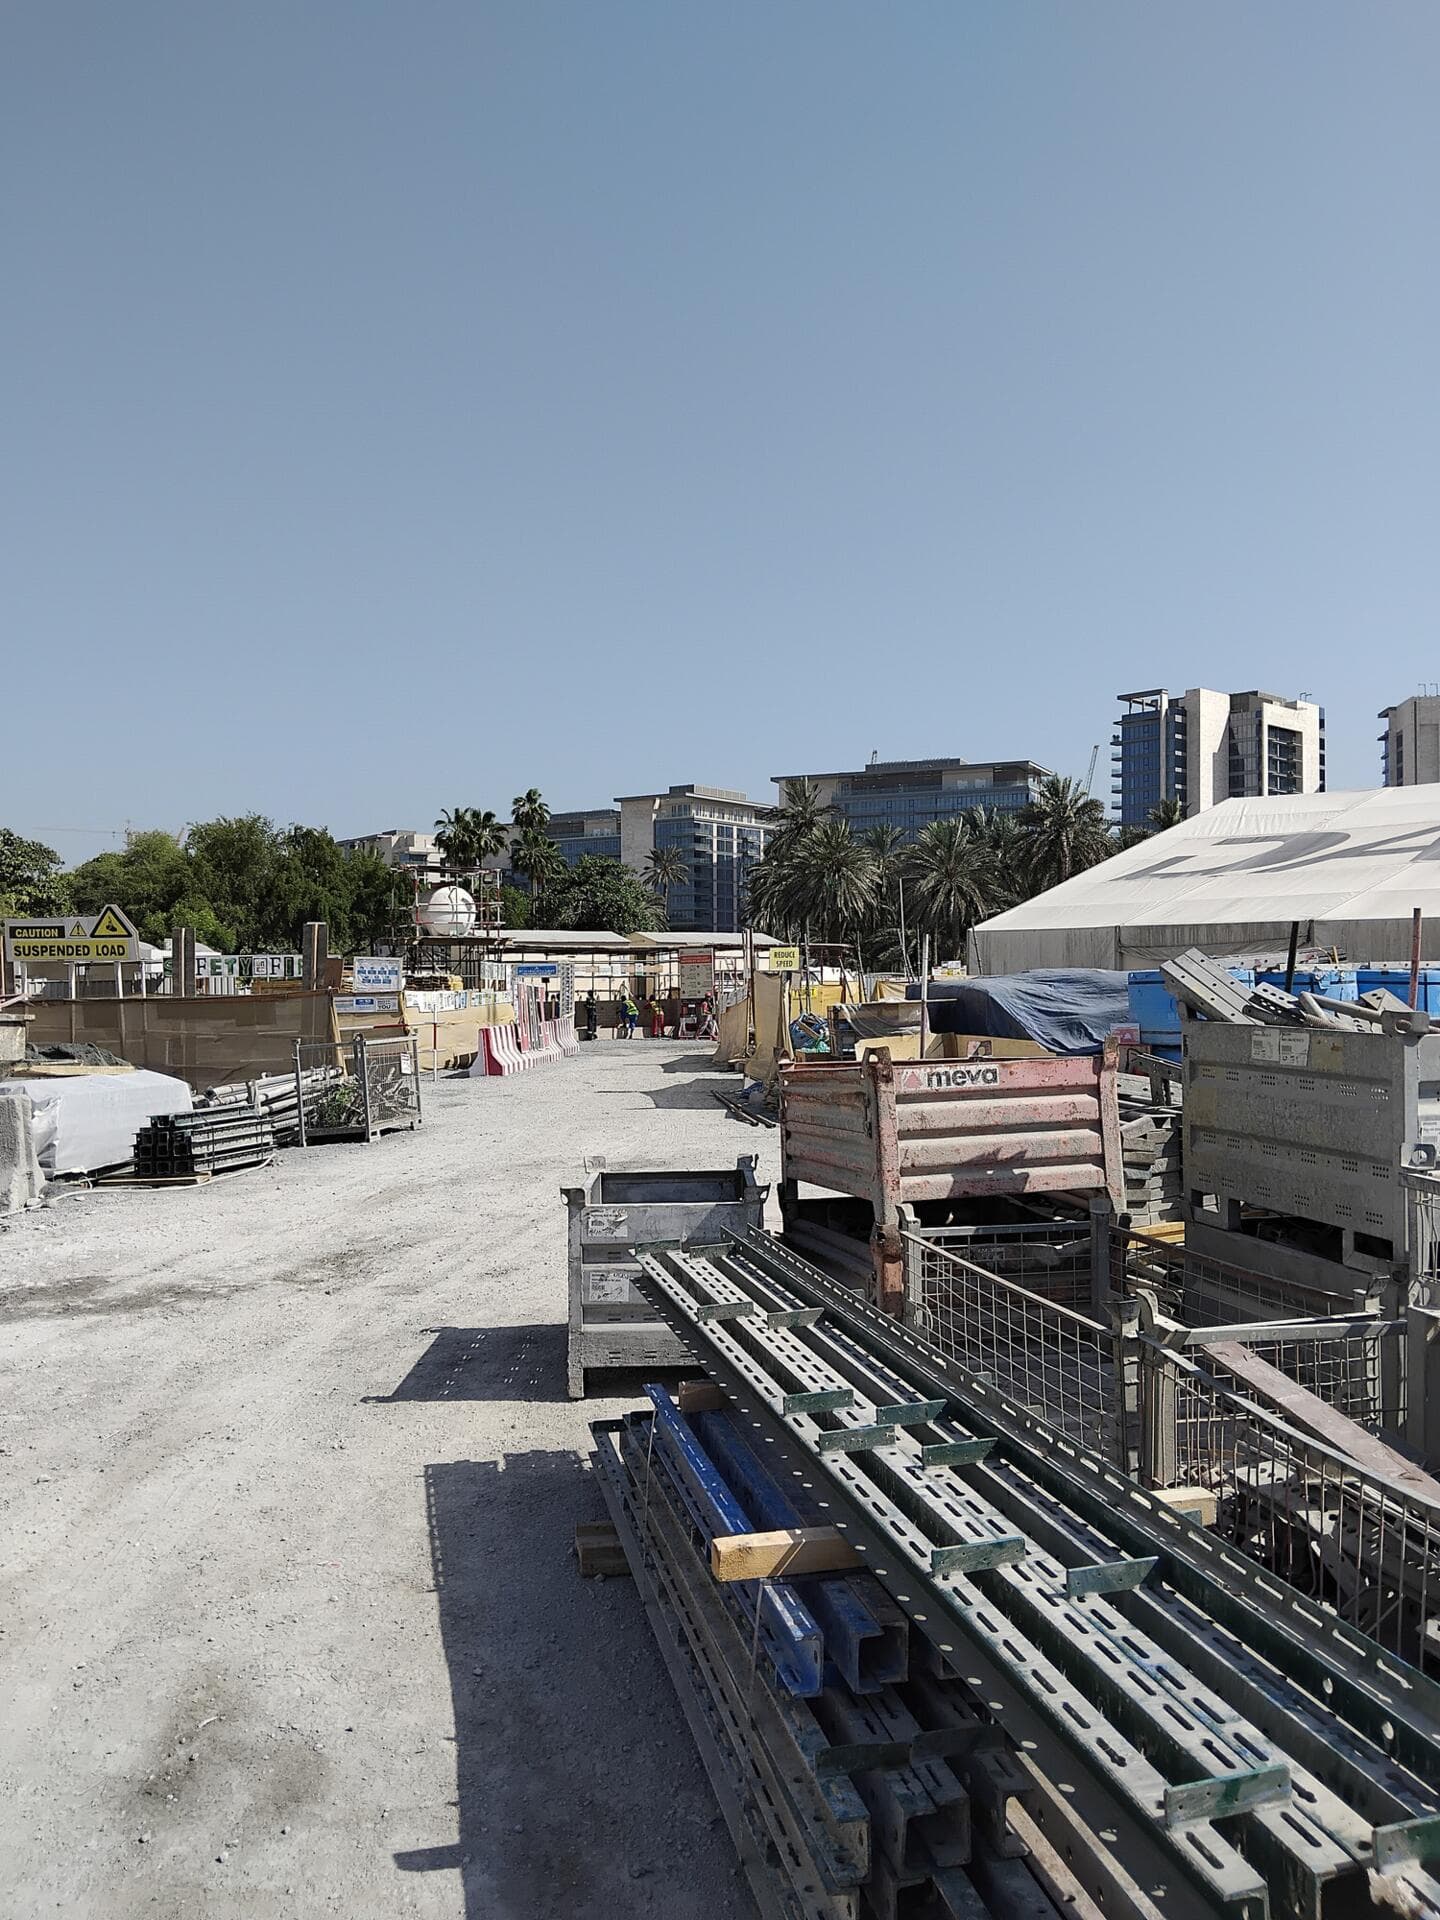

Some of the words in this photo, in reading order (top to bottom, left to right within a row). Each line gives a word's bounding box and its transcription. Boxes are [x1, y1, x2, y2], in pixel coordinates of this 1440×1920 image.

[15, 928, 59, 938] CAUTION
[13, 945, 91, 957] SUSPENDED
[95, 944, 126, 957] LOAD
[774, 951, 795, 959] REDUCE
[164, 957, 253, 977] SFETY
[775, 960, 793, 968] SPEED
[926, 1067, 999, 1088] meva
